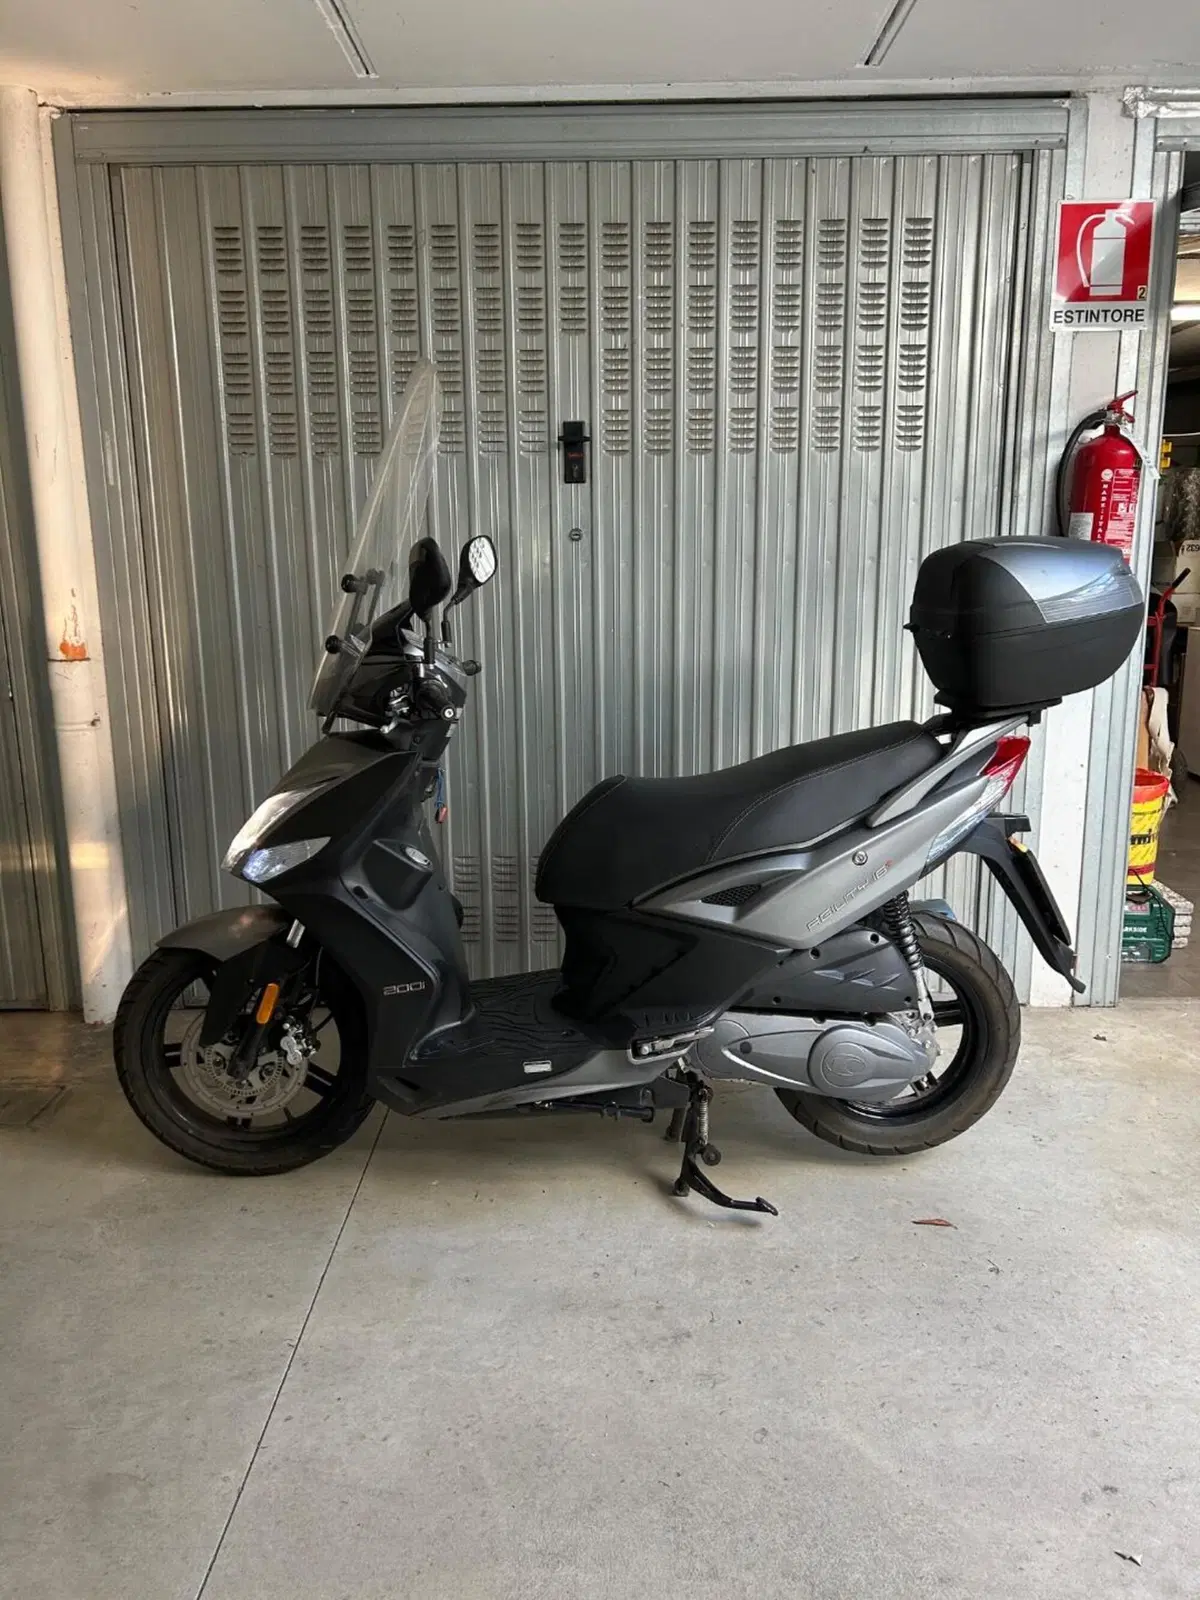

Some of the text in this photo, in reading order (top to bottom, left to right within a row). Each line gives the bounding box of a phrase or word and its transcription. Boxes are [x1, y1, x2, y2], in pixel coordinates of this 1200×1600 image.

[1138, 287, 1146, 299] 2
[1053, 309, 1145, 324] ESTINTORE
[806, 880, 869, 932] AGILITY
